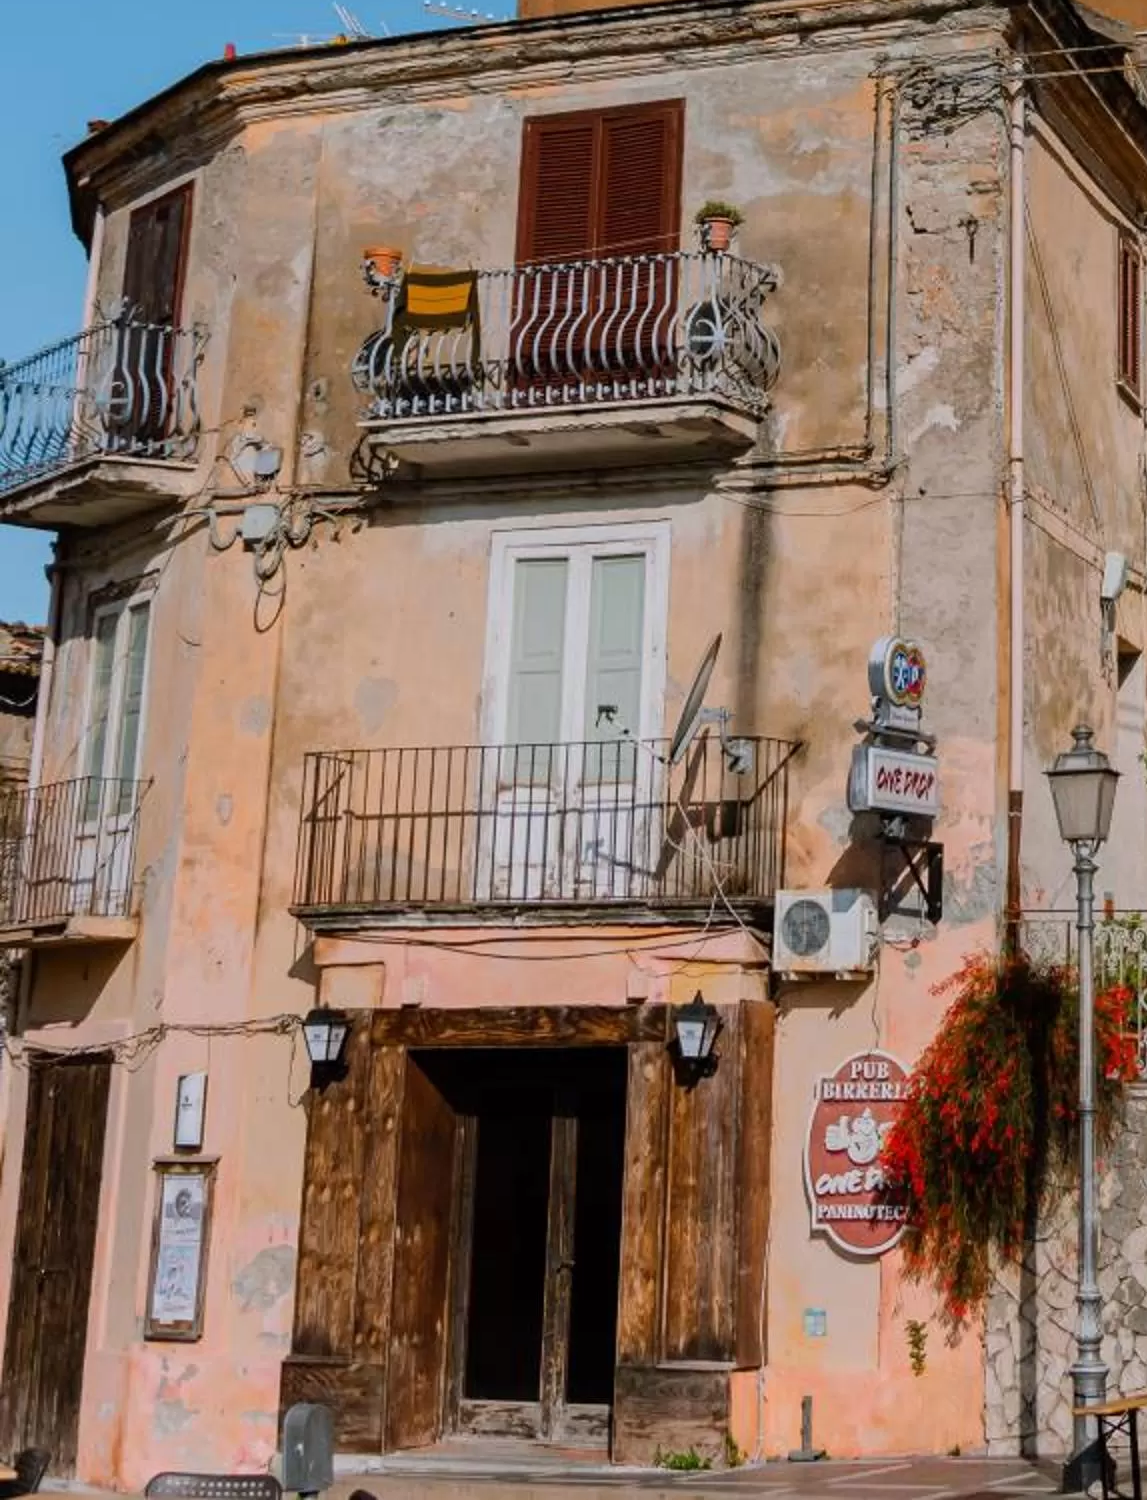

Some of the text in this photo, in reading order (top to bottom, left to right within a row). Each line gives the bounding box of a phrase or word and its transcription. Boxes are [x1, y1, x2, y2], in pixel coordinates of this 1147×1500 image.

[850, 1061, 889, 1079] PUB
[823, 1082, 908, 1099] BIRRERI
[815, 1169, 864, 1195] ONE
[817, 1203, 908, 1220] PANINOTEC
